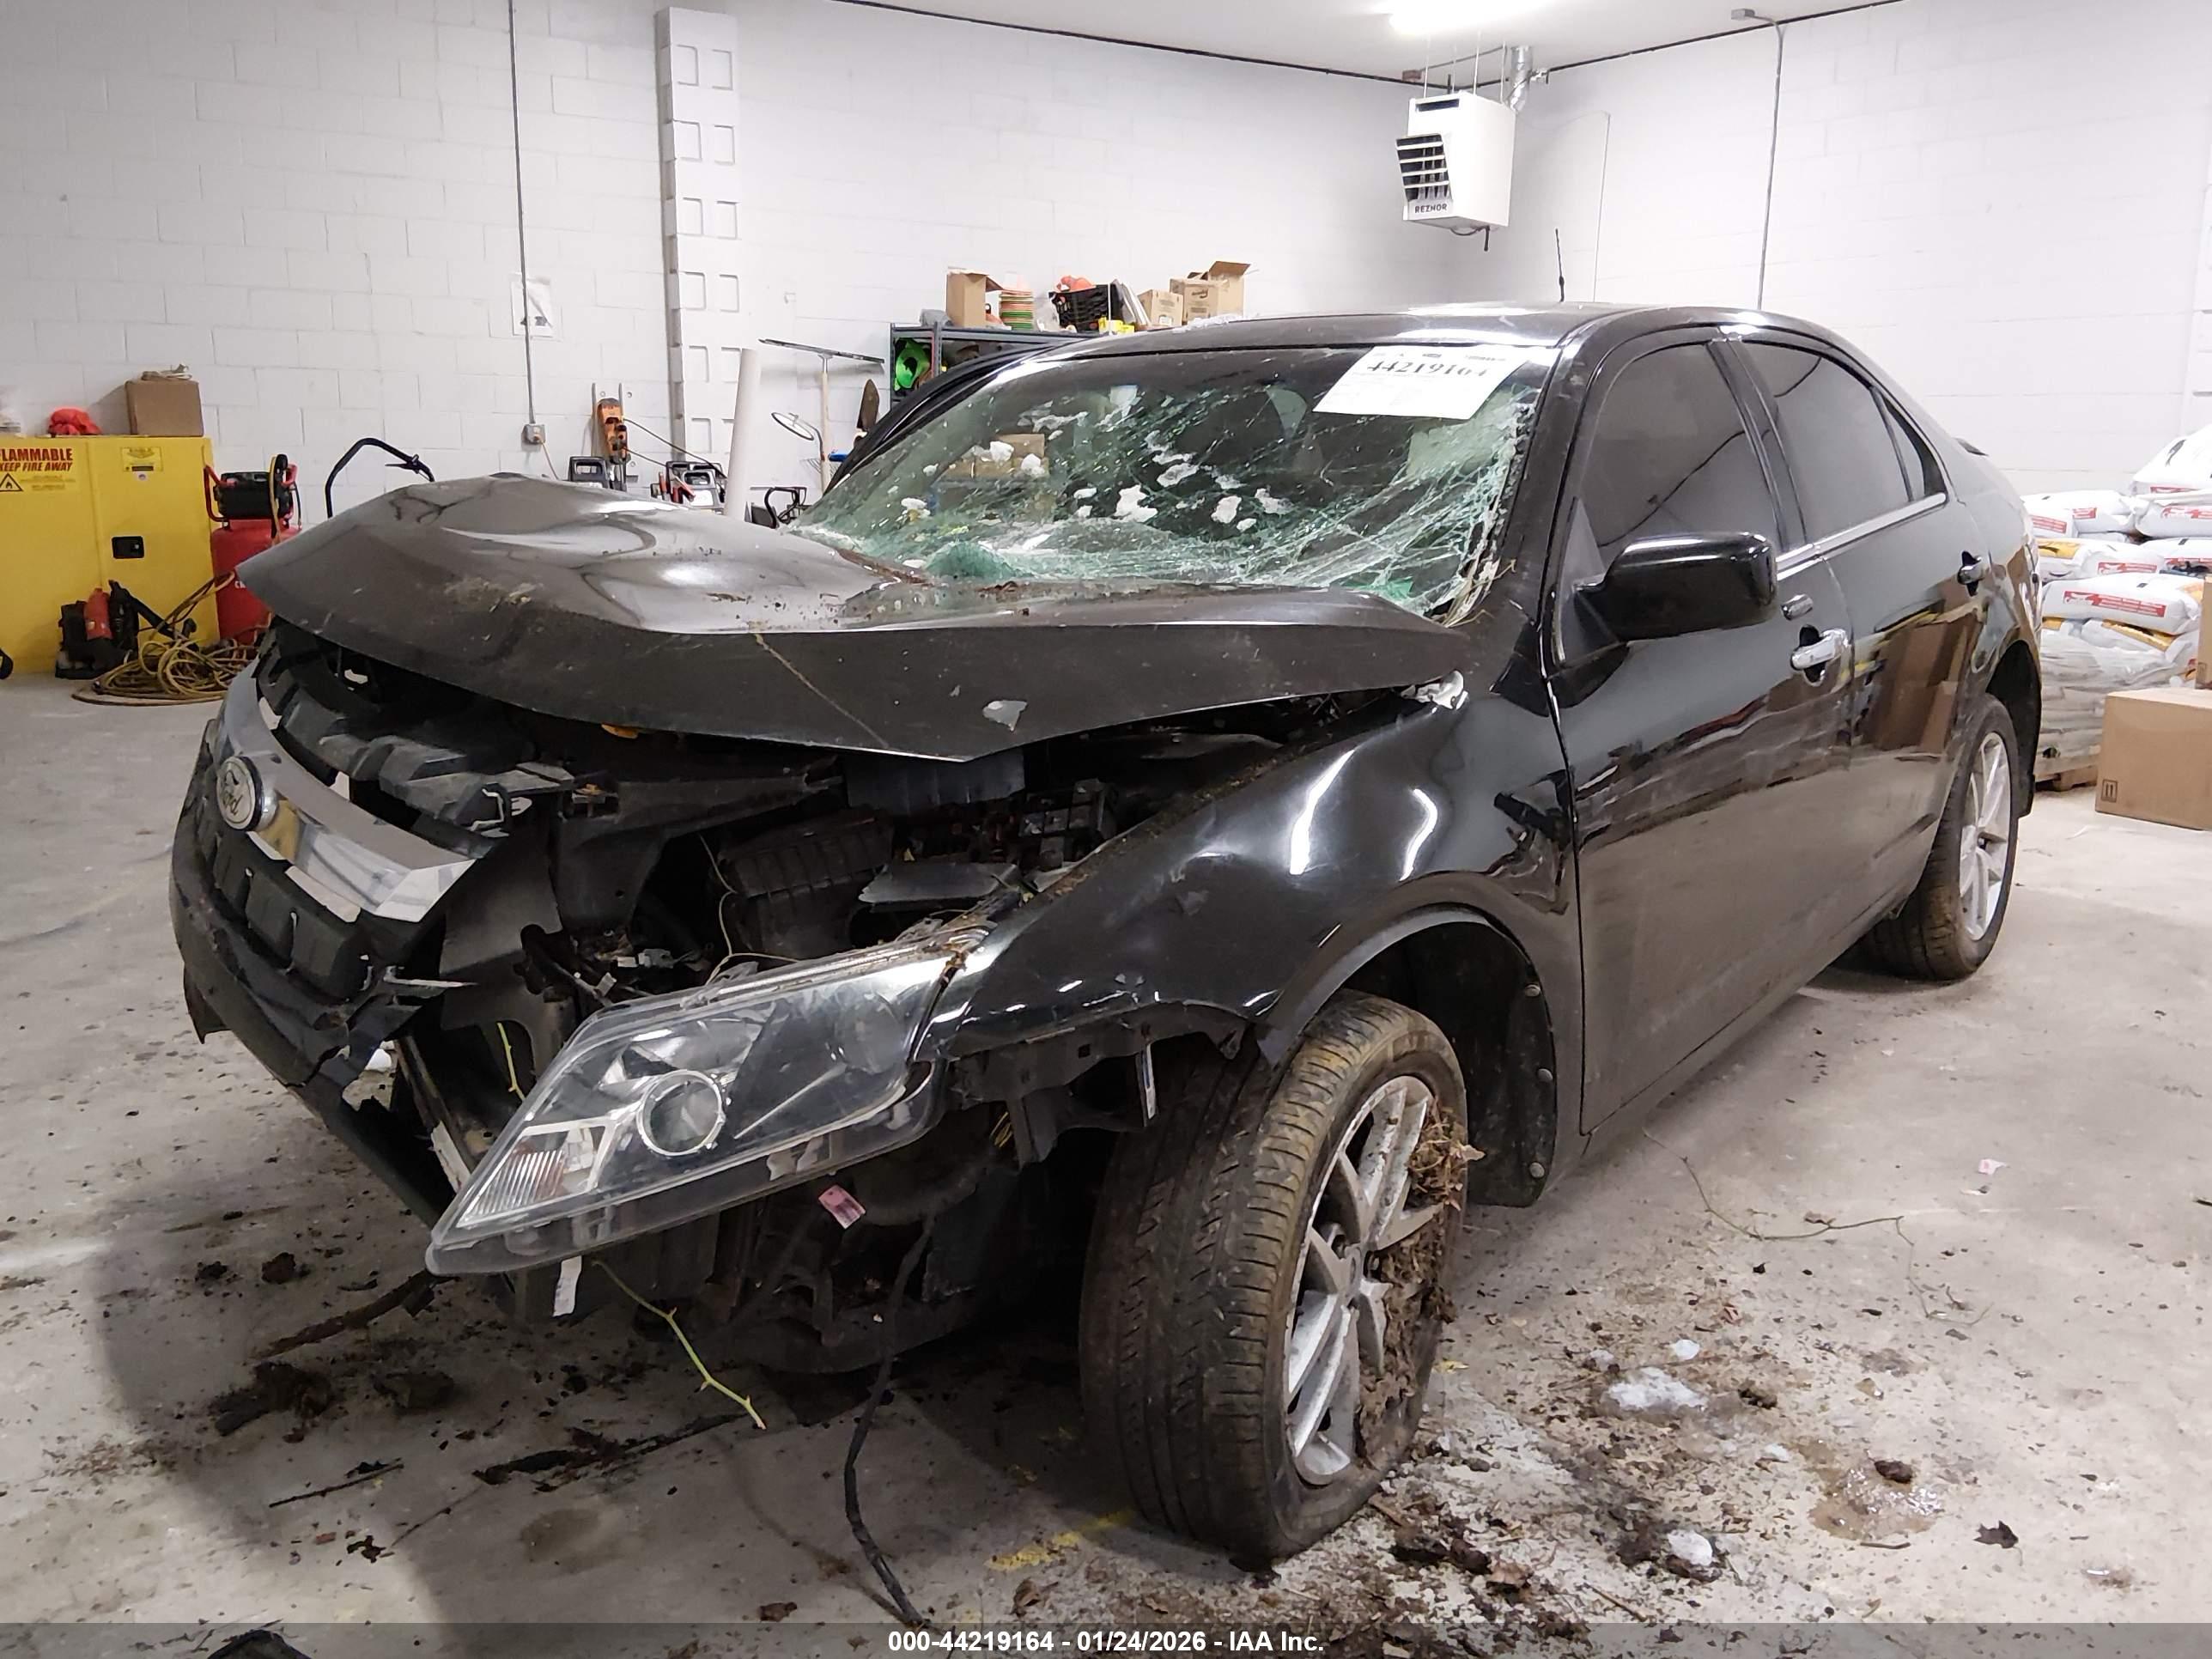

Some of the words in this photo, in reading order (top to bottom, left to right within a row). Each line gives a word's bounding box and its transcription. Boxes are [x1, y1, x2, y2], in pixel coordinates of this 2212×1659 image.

[1414, 204, 1448, 214] REZNOR
[0, 448, 73, 461] LAMMABLE
[22, 462, 43, 471] FIRE
[45, 462, 72, 471] AWAY
